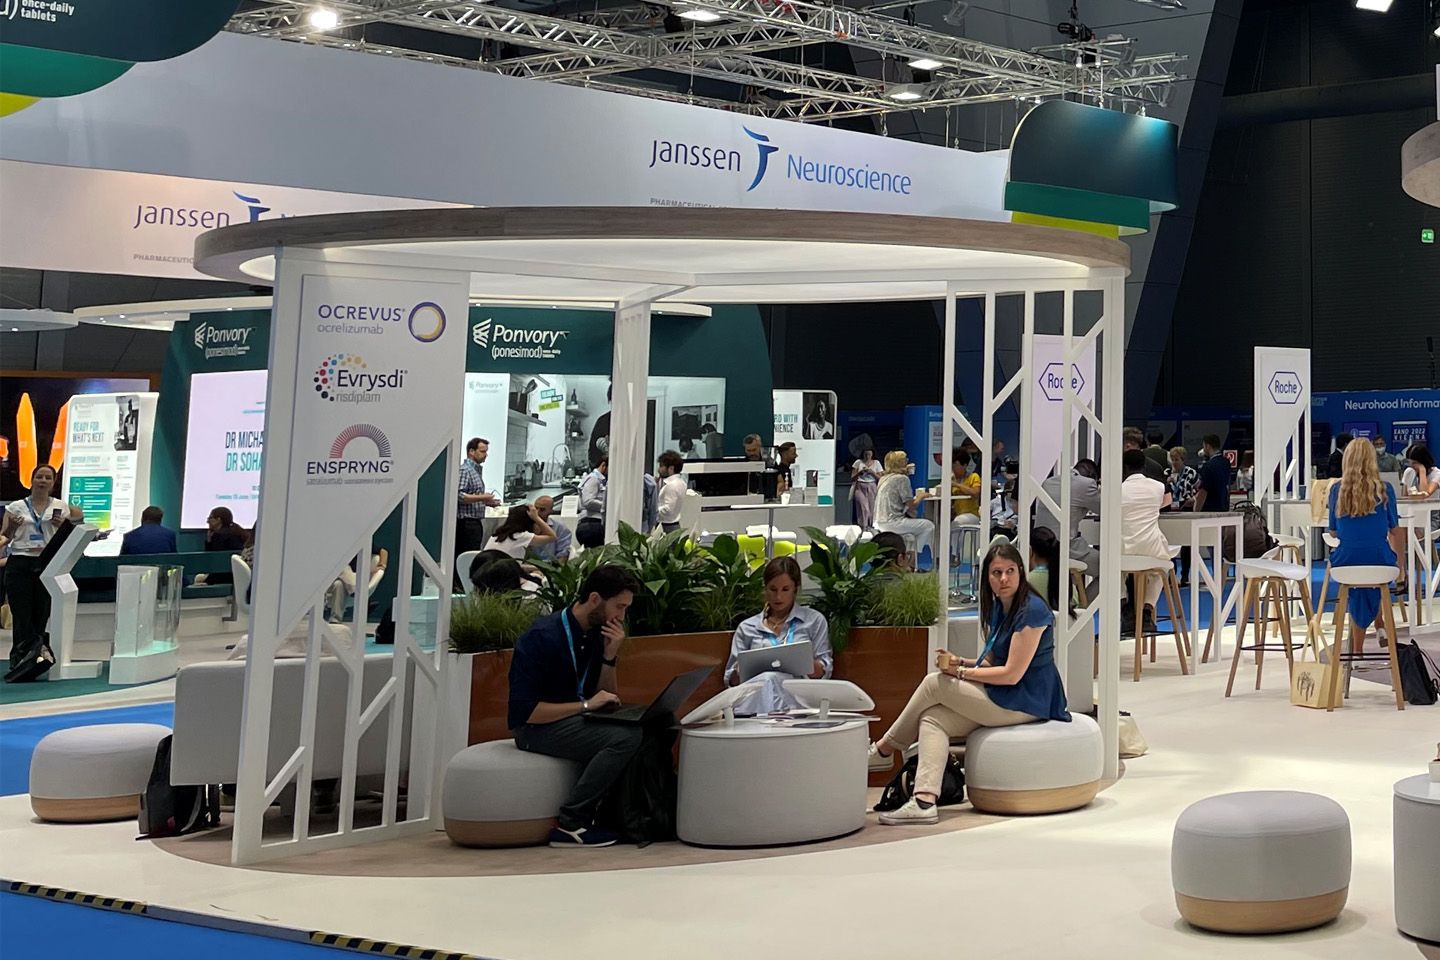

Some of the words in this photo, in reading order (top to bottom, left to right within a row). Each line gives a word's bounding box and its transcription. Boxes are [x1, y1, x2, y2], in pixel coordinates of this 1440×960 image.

[20, 7, 57, 22] tablets
[787, 153, 912, 195] Neuroscience
[206, 326, 251, 344] Ponvory
[317, 323, 384, 335] ocrelizumab
[493, 324, 560, 347] Ponvory
[337, 369, 404, 392] Evrysdi
[1047, 373, 1078, 389] Roce
[1274, 380, 1297, 394] Roche
[1345, 398, 1399, 410] Neurohood
[784, 413, 798, 423] WITH
[225, 431, 236, 448] DR
[225, 452, 238, 472] DR
